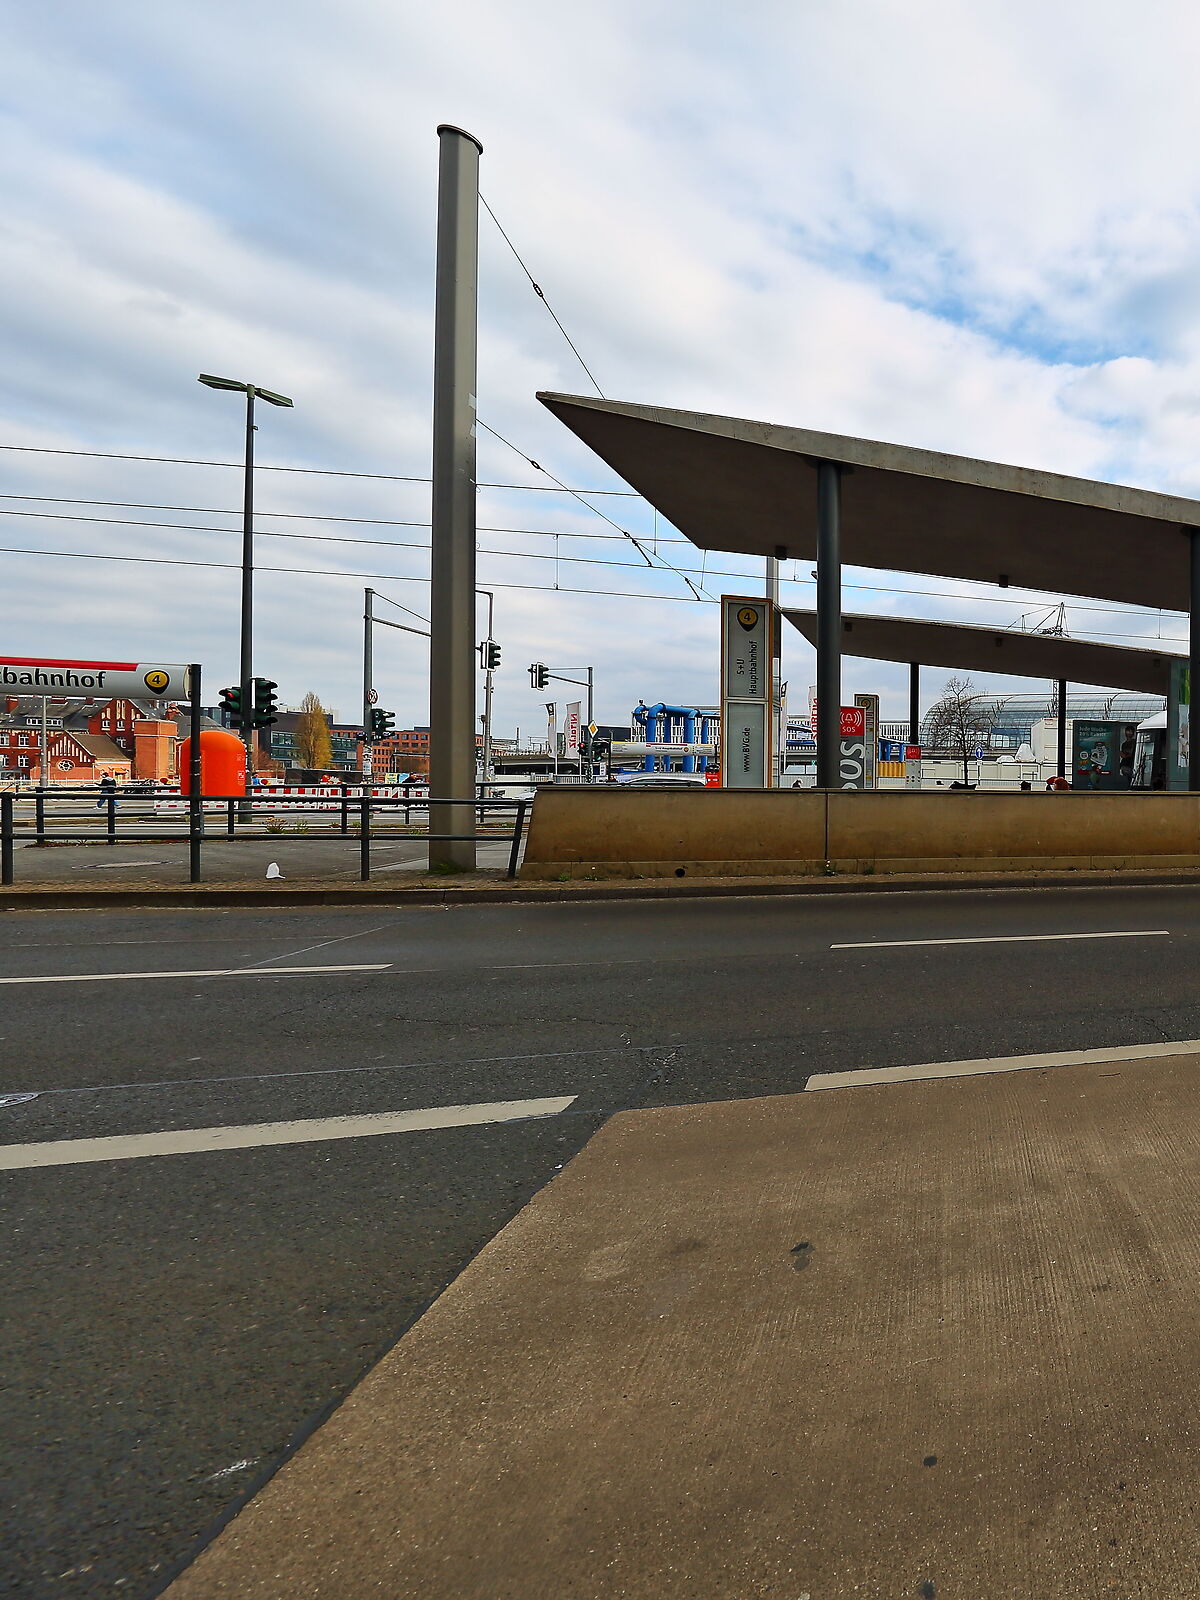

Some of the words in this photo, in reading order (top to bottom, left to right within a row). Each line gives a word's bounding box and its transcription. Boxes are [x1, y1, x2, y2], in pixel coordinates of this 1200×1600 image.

[744, 612, 751, 621] 4
[737, 659, 745, 675] S+U
[749, 641, 759, 694] Hauptbahnhof
[152, 674, 161, 685] 4
[742, 727, 751, 773] www.BVG.de
